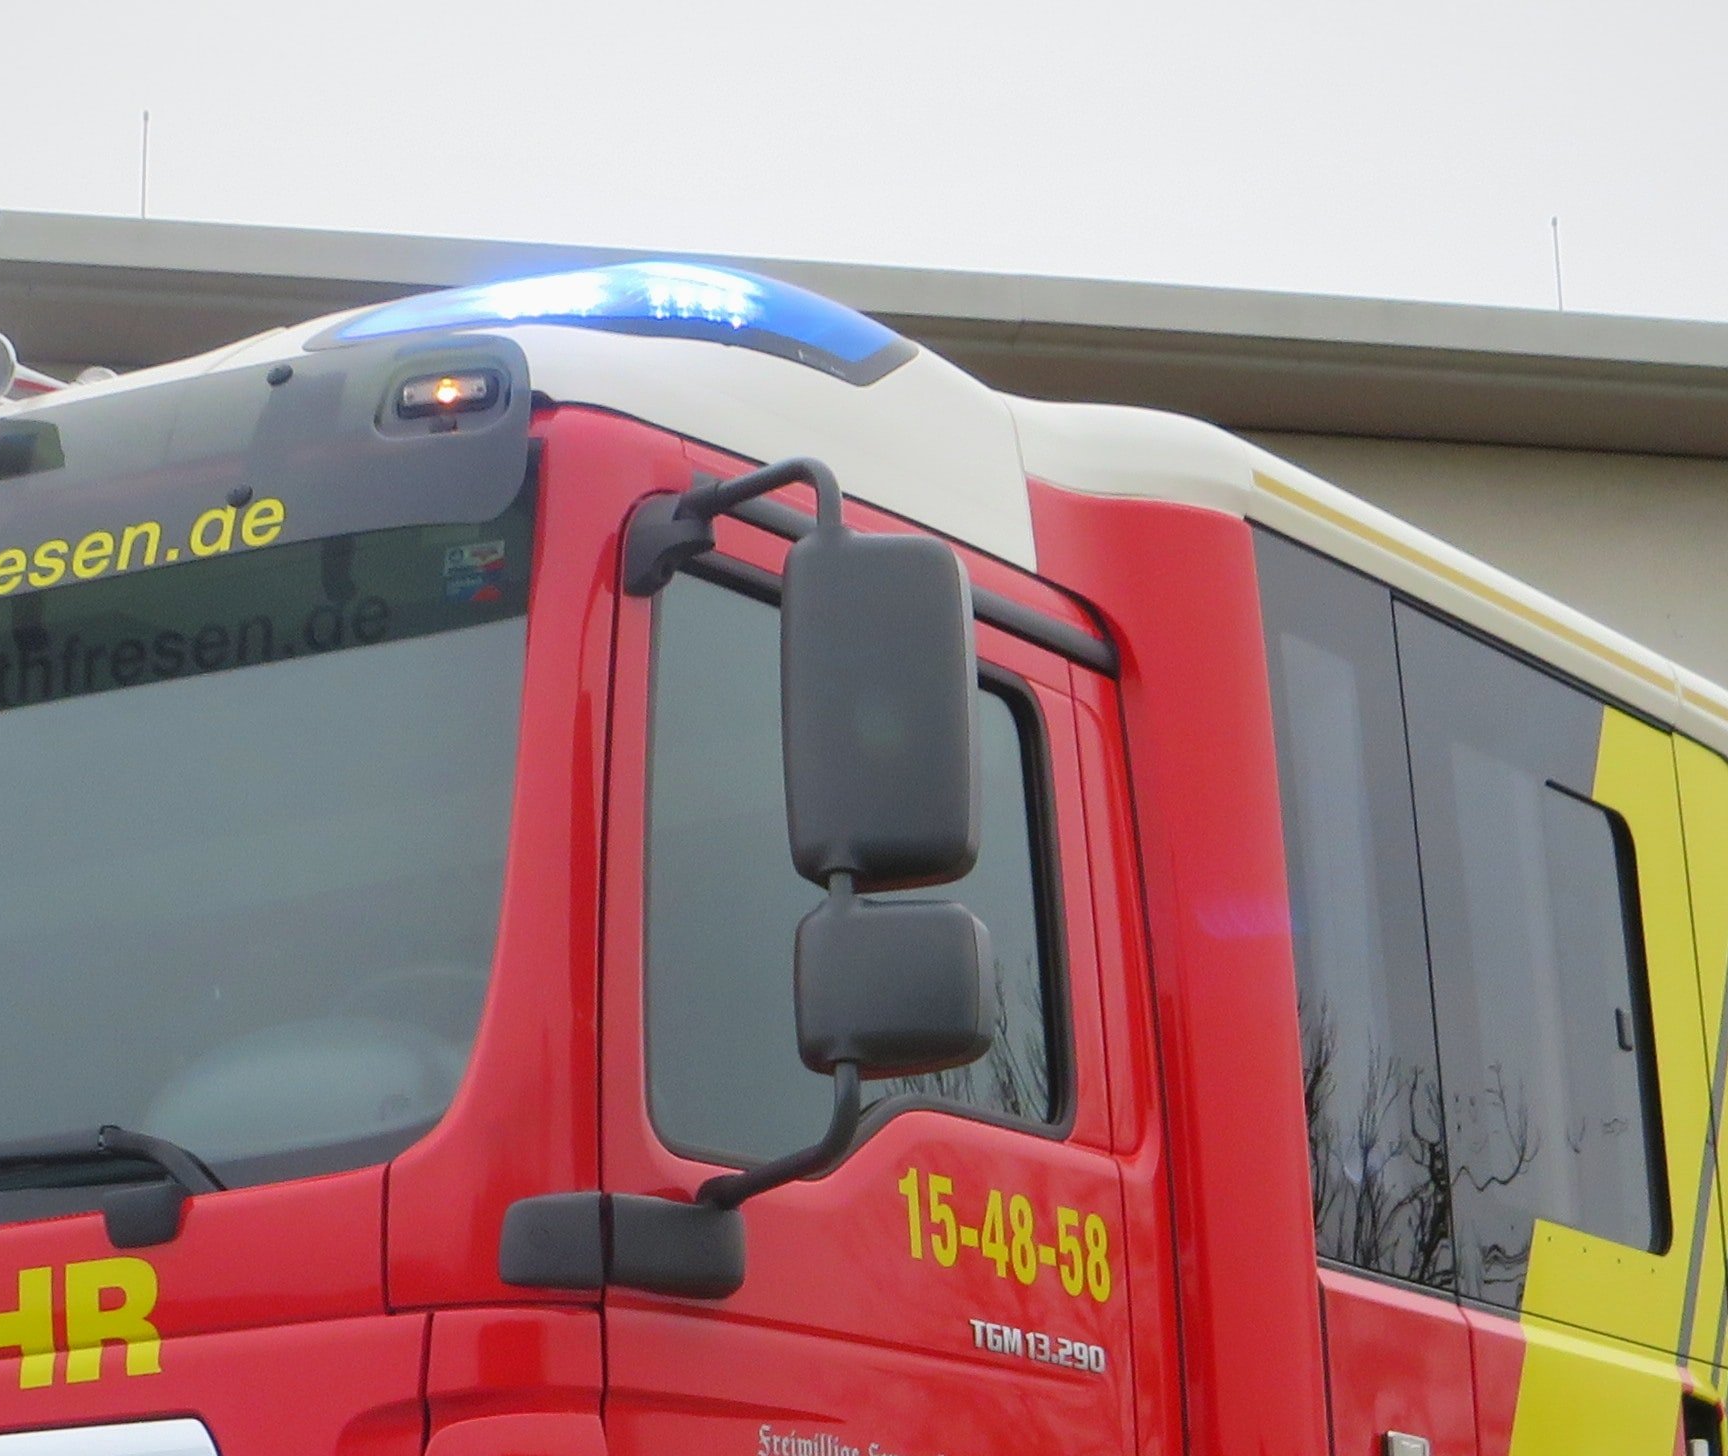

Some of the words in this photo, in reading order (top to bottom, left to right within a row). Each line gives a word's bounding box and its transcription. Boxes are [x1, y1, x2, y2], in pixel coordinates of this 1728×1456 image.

[898, 1167, 1111, 1303] 15-48-58
[969, 1319, 1022, 1358] TGM
[1026, 1331, 1107, 1374] 13.290
